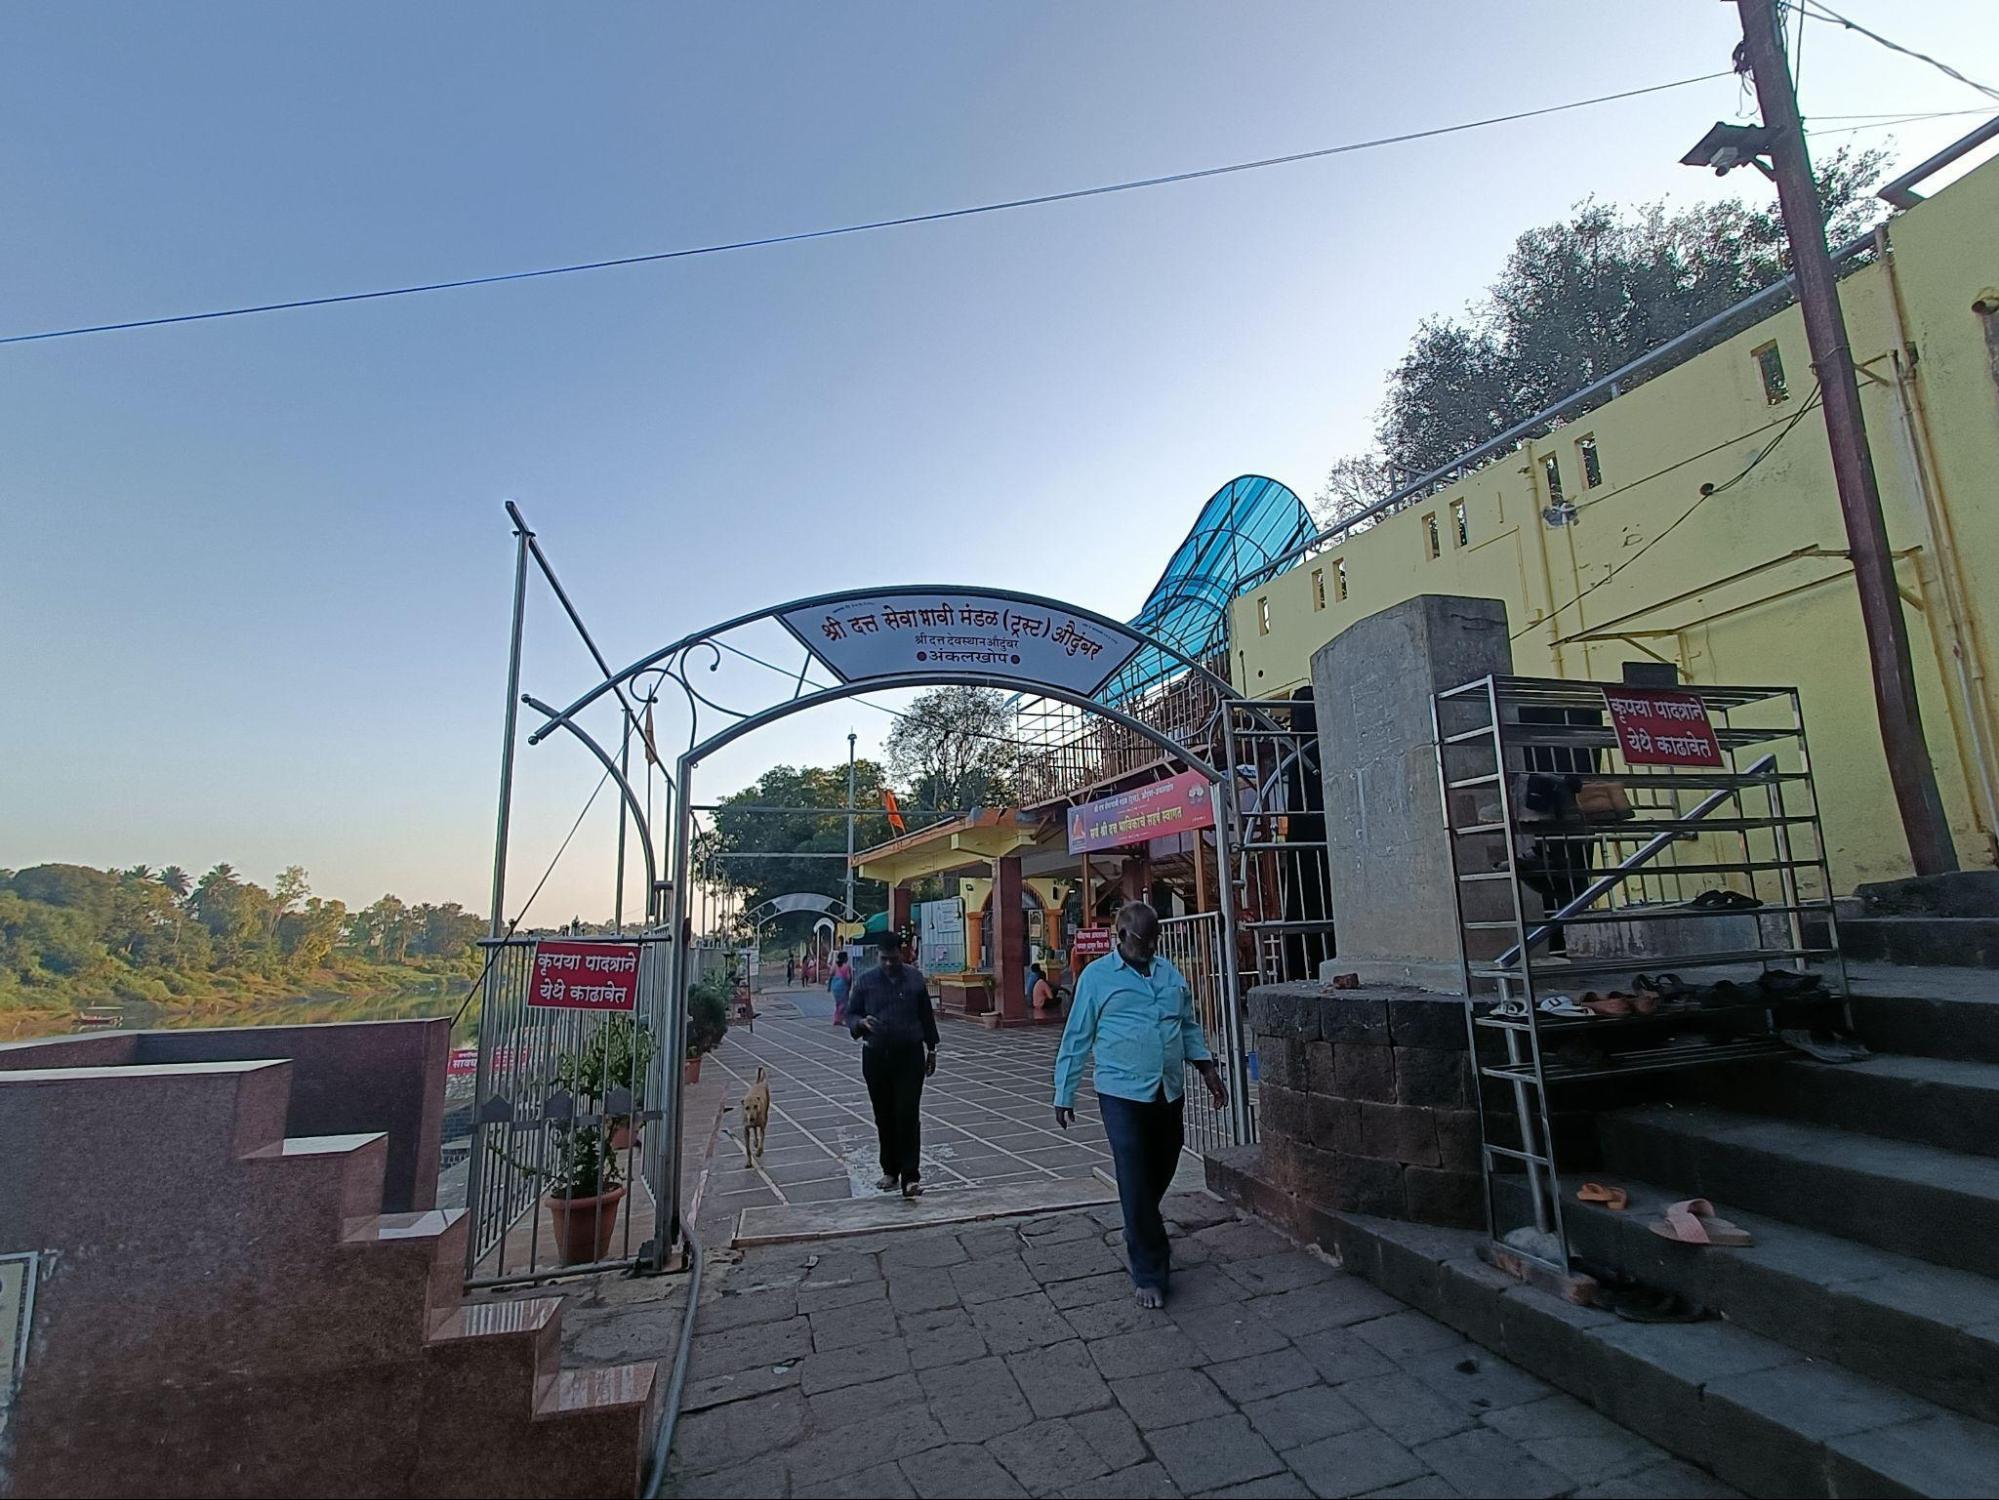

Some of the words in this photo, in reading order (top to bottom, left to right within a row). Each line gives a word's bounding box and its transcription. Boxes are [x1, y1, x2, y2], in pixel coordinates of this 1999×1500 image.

[821, 616, 847, 641] श्री
[848, 614, 879, 635] दत्त
[957, 603, 999, 627] मंडळ
[1003, 608, 1050, 639] (ट्रस्ट)
[1051, 620, 1103, 661] औदुंबर
[915, 632, 927, 645] श्री
[929, 635, 945, 646] दत्त
[947, 633, 986, 646] देवस्थान
[929, 648, 1009, 664] अंकलखोप
[1608, 698, 1653, 724] कृपया
[1653, 698, 1705, 721] पादत्राने
[1627, 727, 1654, 753] येथे
[1655, 731, 1712, 758] काढावेत
[537, 952, 581, 976] कृपया
[585, 952, 637, 973] पादत्राने
[540, 978, 566, 1001] येथे
[570, 980, 628, 1004] काढावेत
